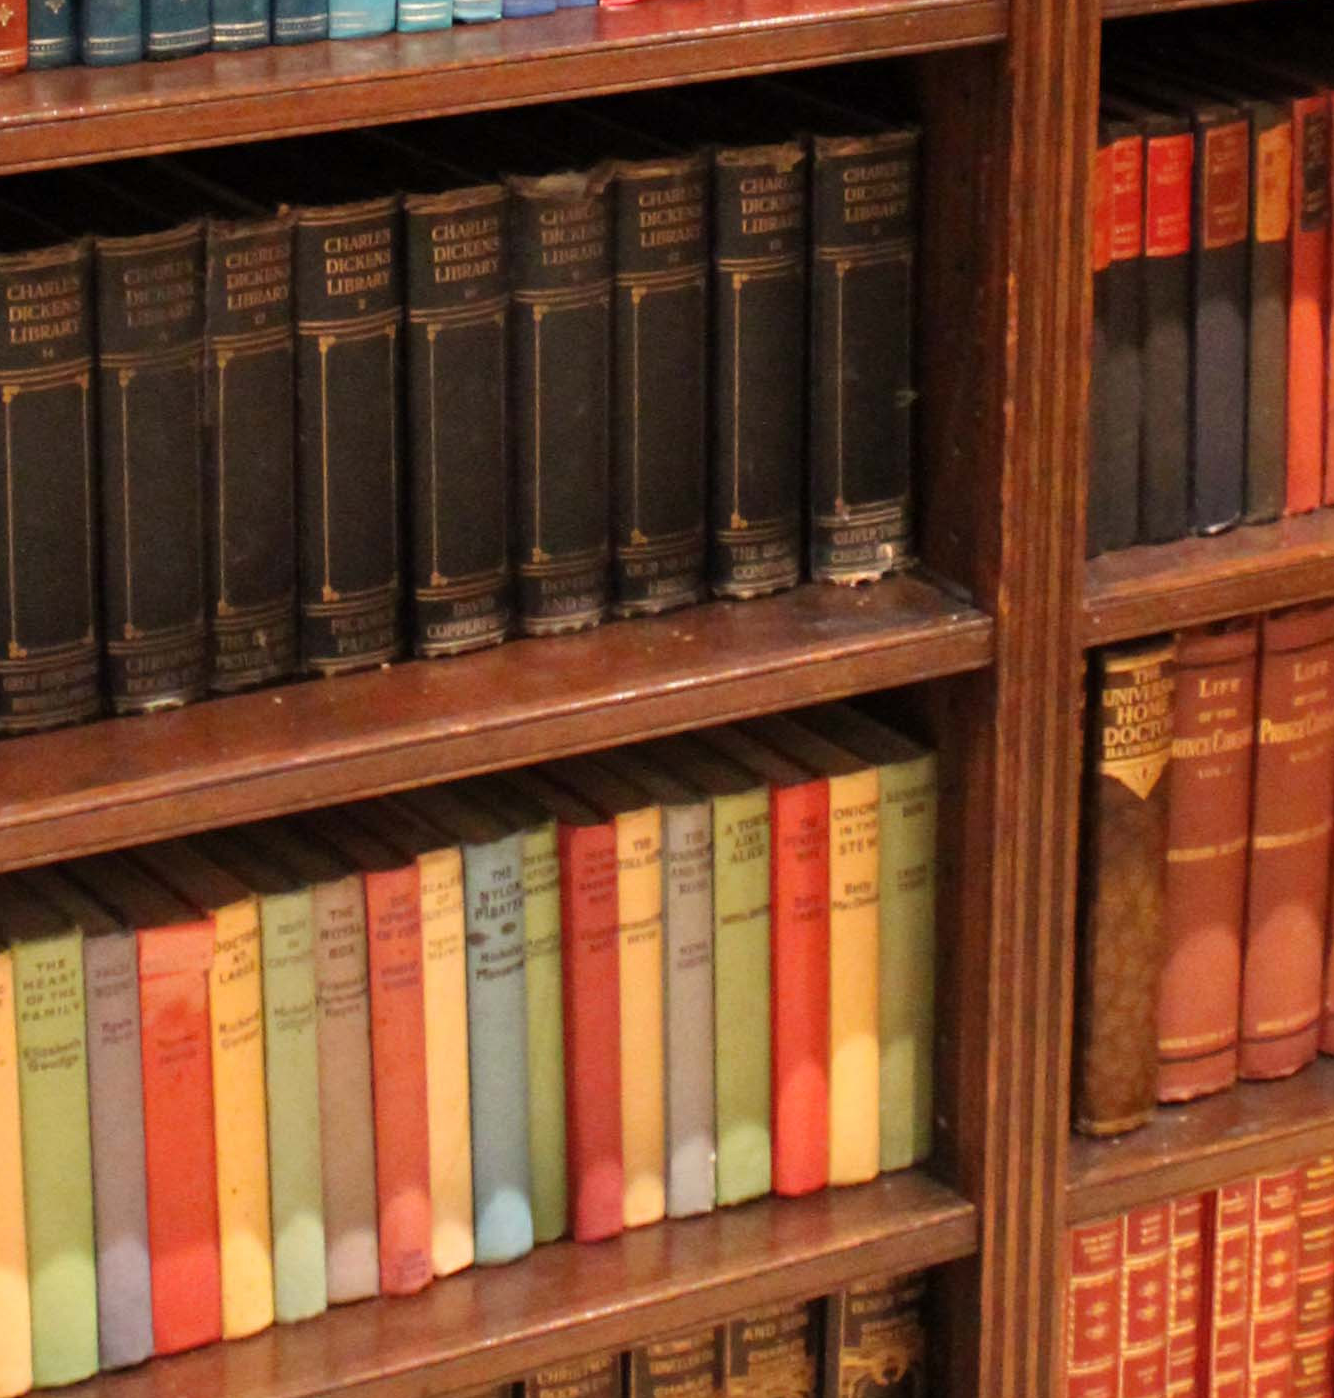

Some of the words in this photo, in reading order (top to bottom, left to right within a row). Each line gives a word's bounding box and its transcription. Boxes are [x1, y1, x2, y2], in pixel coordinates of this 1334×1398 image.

[739, 172, 801, 194] CHARLES
[843, 161, 907, 183] CHARLES
[638, 183, 703, 208] CHARLES
[741, 193, 802, 215] DICKENS
[844, 181, 907, 203] DICKENS
[639, 203, 704, 228] DICKENS
[742, 212, 801, 235] LIBRARY
[845, 199, 907, 224] LIBRARY
[324, 227, 392, 254] CHARLES
[431, 216, 500, 242] CHARLES
[541, 221, 606, 246] DICKENS
[640, 223, 704, 248] LIBRARY
[225, 244, 290, 270] CHARLES
[325, 249, 393, 275] DICKENS
[433, 237, 501, 263] DICKENS
[542, 242, 605, 267] LIBRARY
[227, 264, 291, 290] DICKENS
[435, 257, 501, 284] LIBRARY
[7, 275, 81, 301] CHARLES
[125, 281, 195, 306] DICKENS
[326, 270, 392, 297] LIBRARY
[8, 297, 83, 323] DICKENS
[227, 285, 291, 312] LIBRARY
[127, 303, 194, 329] LIBRARY
[10, 318, 81, 345] LIBRARY
[723, 822, 733, 836] A
[738, 811, 770, 833] TOWN
[839, 825, 854, 838] IN
[854, 819, 878, 835] THE
[632, 836, 653, 852] THE
[684, 828, 706, 846] THE
[733, 831, 763, 849] LIKE
[838, 838, 877, 857] STEW
[730, 844, 766, 864] ALICE
[491, 865, 514, 882] THE
[479, 881, 523, 905] NYLON
[844, 881, 872, 897] Betty
[329, 905, 355, 922] THE
[474, 898, 525, 921] PIRATES
[213, 925, 262, 955] DOCTOR
[319, 923, 363, 942] ROYAL
[232, 948, 248, 964] AT
[328, 943, 356, 960] BOX
[35, 957, 66, 973] THE
[218, 959, 258, 985] LARGE
[22, 968, 78, 992] HEART
[25, 992, 45, 1007] OF
[49, 987, 77, 1001] THE
[21, 1001, 80, 1023] FAMILY
[218, 1008, 261, 1034] Richard
[22, 1037, 82, 1060] Elizabeth
[26, 1053, 80, 1074] Goudge
[742, 1323, 776, 1343] AND
